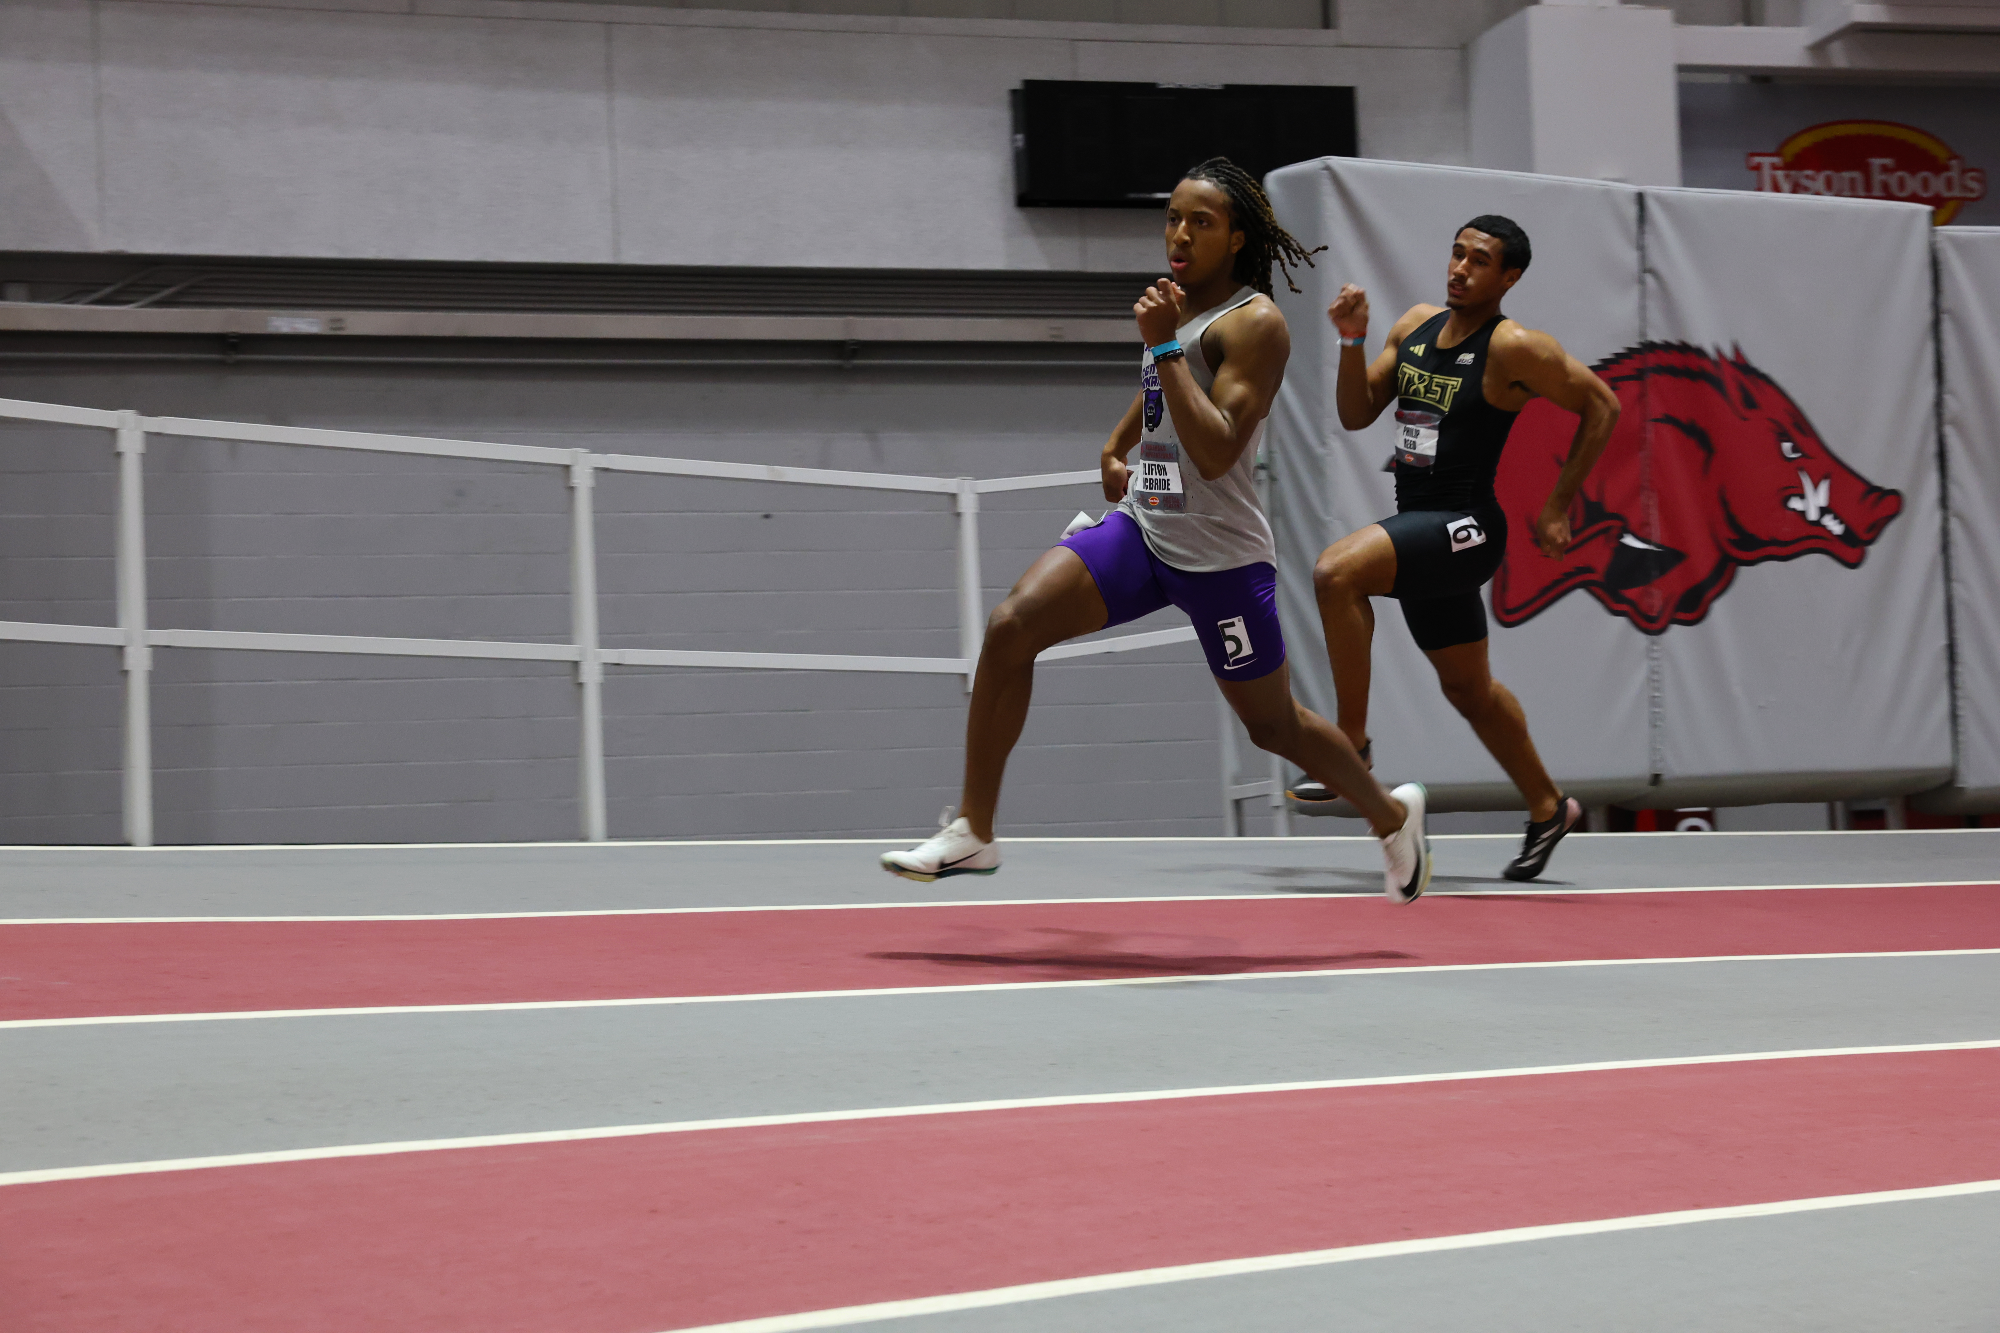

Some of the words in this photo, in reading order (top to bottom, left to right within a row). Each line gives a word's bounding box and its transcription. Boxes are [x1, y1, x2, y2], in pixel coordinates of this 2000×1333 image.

[1749, 155, 1866, 196] Tyson
[1867, 157, 1985, 198] Foods
[1399, 363, 1462, 411] TXST
[1219, 621, 1243, 660] 5
